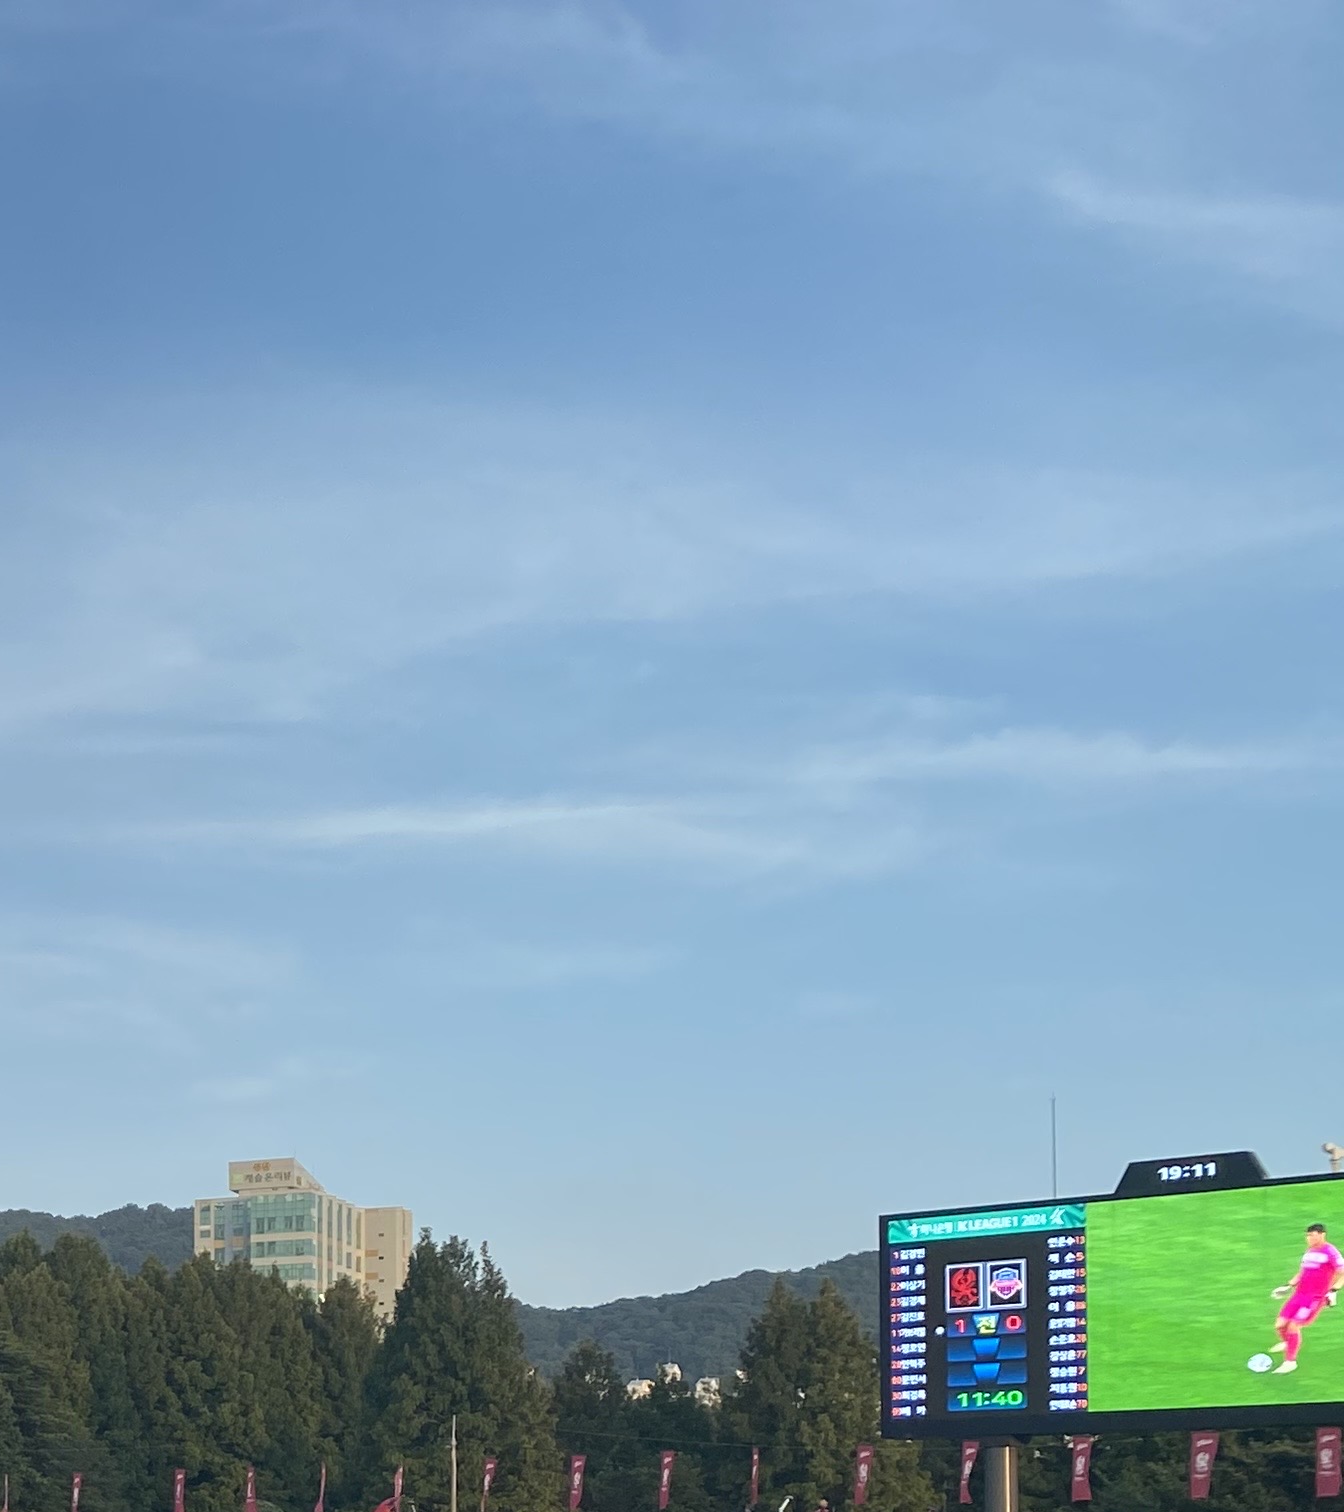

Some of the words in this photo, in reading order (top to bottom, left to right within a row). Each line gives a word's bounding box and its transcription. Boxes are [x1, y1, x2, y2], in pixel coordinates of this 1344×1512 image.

[1156, 1162, 1216, 1181] 19:11
[955, 1319, 966, 1334] 1
[1006, 1315, 1022, 1331] 0
[957, 1390, 1023, 1408] 11:40
